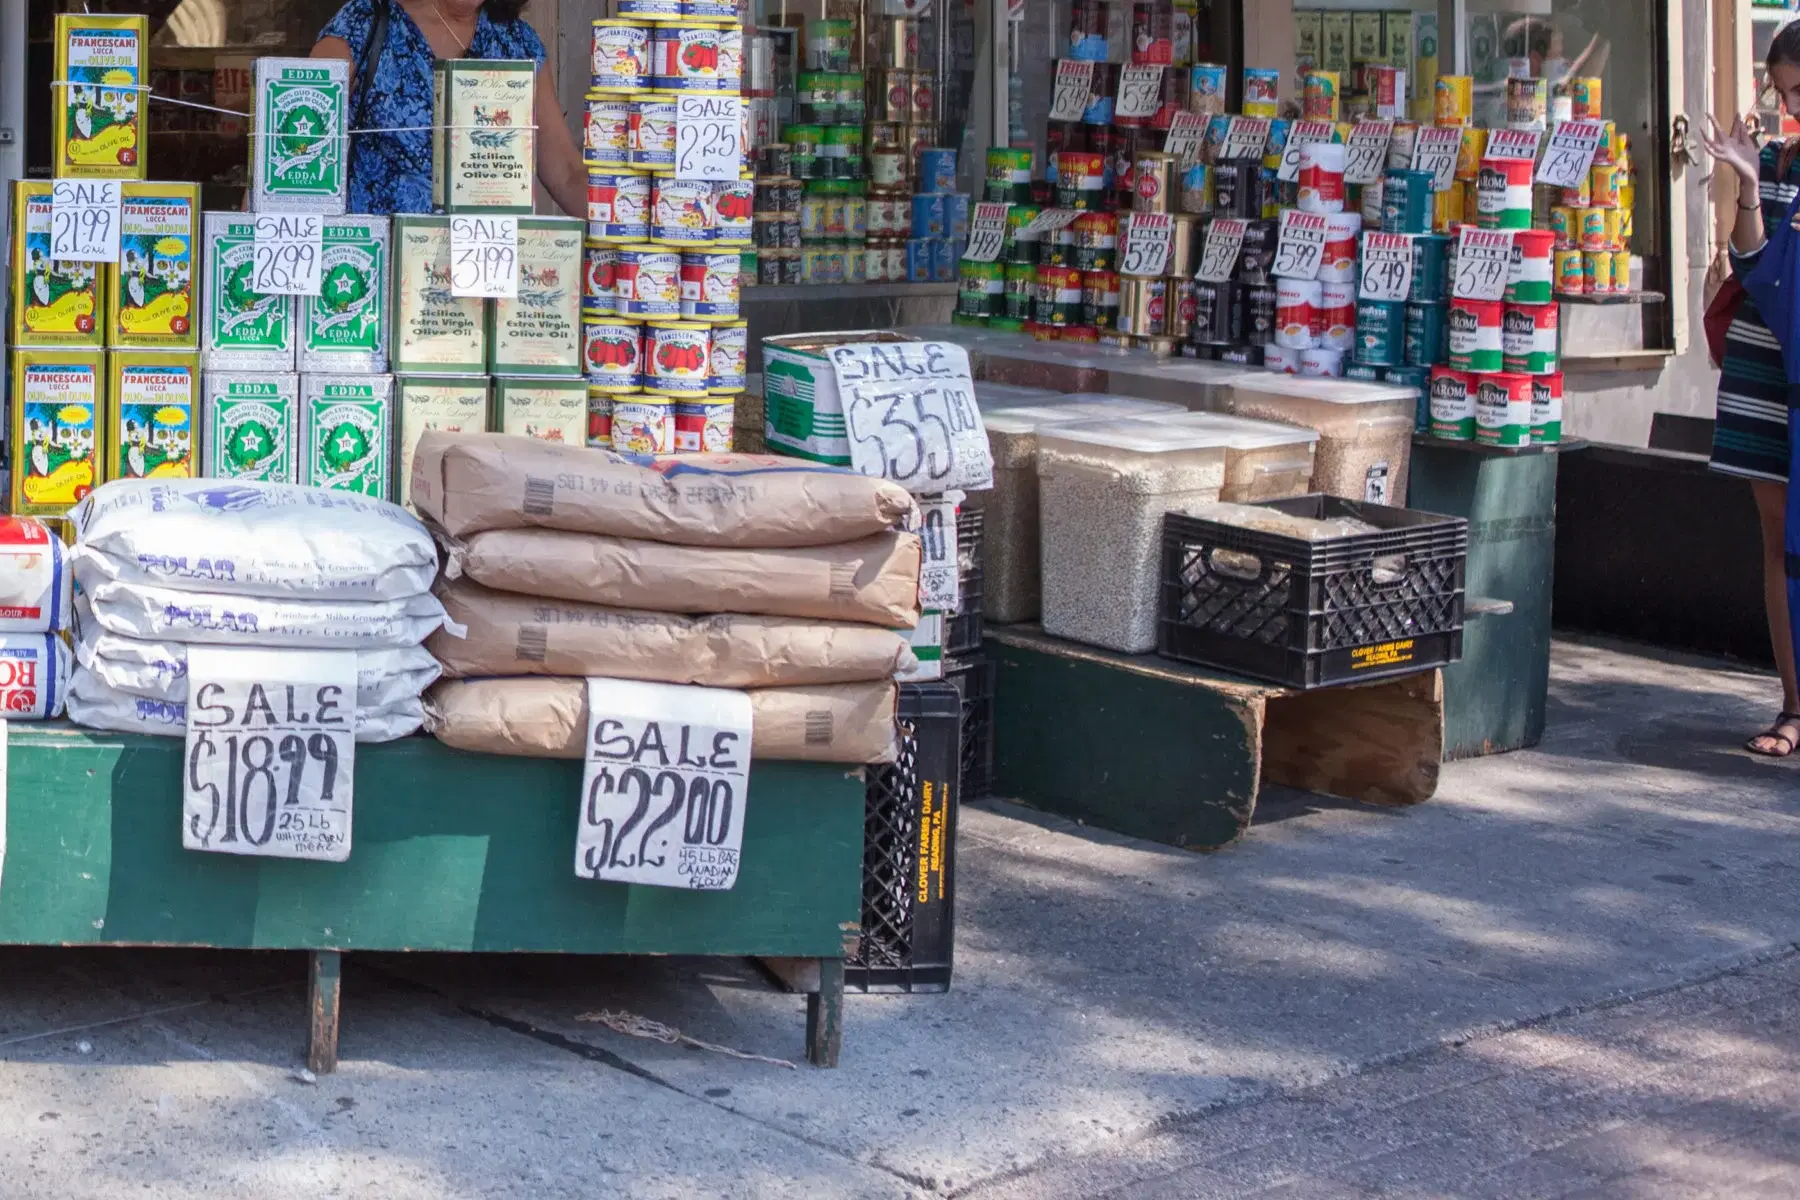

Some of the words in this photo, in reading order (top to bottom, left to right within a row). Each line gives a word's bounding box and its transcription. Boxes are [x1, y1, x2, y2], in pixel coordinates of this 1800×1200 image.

[71, 38, 135, 48] FRANCESCANI
[88, 56, 116, 66] OLIVE
[118, 56, 134, 66] OIL
[288, 70, 323, 80] EDDA
[682, 98, 736, 118] SALE
[469, 152, 515, 160] Sicilian
[492, 162, 523, 170] Virgin
[288, 172, 317, 181] EDDA
[463, 171, 497, 179] Olive
[503, 171, 522, 179] Oil
[54, 182, 115, 204] SALE
[124, 206, 188, 216] FRANCESCANI
[55, 209, 111, 254] 21.99
[256, 217, 318, 239] SALE
[329, 228, 364, 237] EDDA
[452, 218, 514, 241] SALE
[256, 244, 315, 290] 26.99
[451, 247, 514, 290] 34.99
[835, 343, 951, 381] SALE
[141, 553, 236, 583] POLAR
[164, 604, 260, 633] POLAR
[194, 682, 344, 727] SALE
[593, 718, 740, 769] SALE
[190, 730, 340, 848] $18.99
[922, 779, 933, 816] DAIRY
[279, 813, 305, 829] 25
[584, 768, 735, 879] $22.00
[932, 809, 942, 825] PA
[919, 815, 931, 855] FARMS
[677, 862, 737, 876] CANADIAN
[717, 850, 738, 866] BAG
[918, 856, 930, 905] CLOVER
